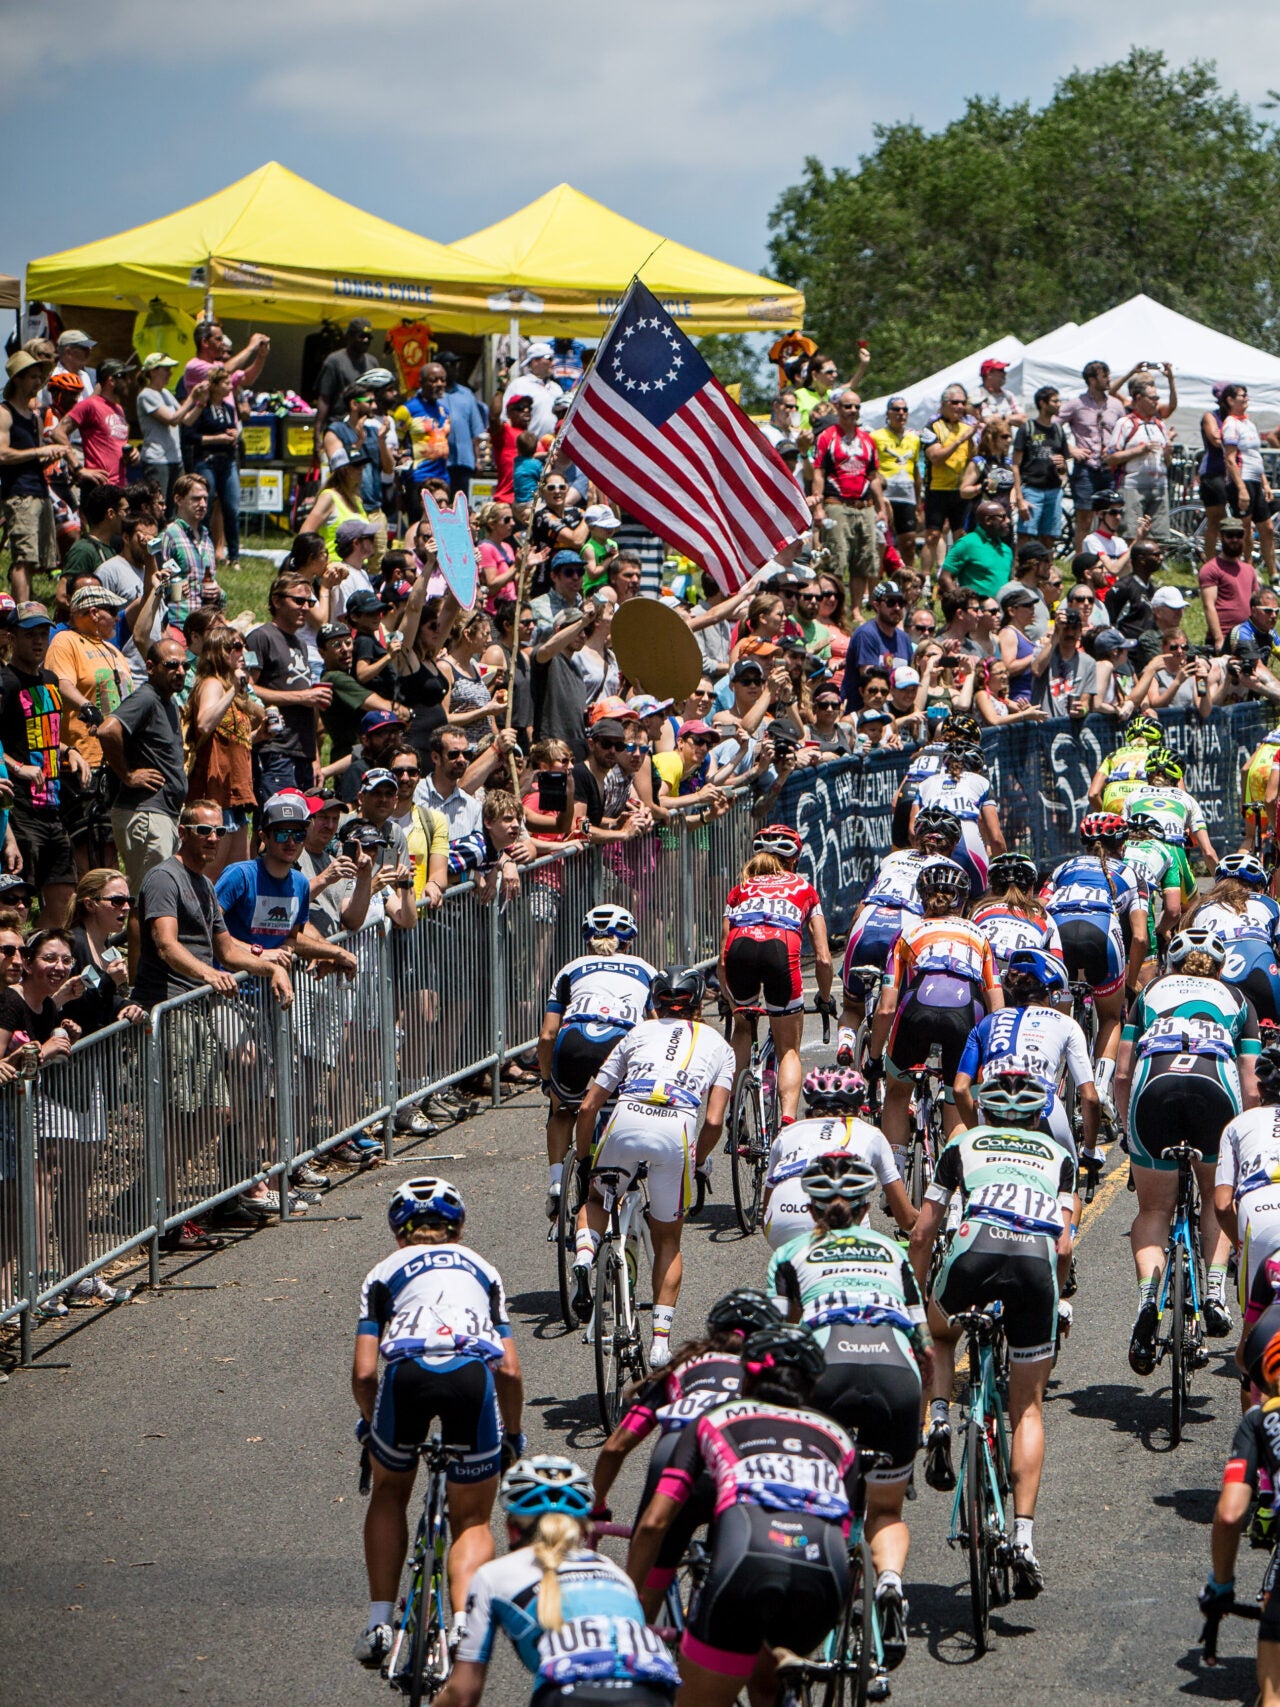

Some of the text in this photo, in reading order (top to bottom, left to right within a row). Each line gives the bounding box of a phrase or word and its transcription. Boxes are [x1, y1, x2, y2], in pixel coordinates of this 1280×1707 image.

[333, 276, 434, 304] LONGS CYCLE
[1084, 886, 1101, 901] 71
[768, 899, 799, 919] 134
[580, 961, 640, 977] bigla
[1035, 1009, 1063, 1021] UHC
[991, 1012, 1018, 1053] UHC
[1198, 1020, 1225, 1041] 55
[665, 1025, 685, 1062] COLOMBIA
[626, 1101, 679, 1120] COLOMBIA
[974, 1135, 1055, 1161] COLAVITA
[985, 1155, 1046, 1172] Bianchi
[779, 1202, 809, 1216] COLO
[980, 1183, 1060, 1223] 172 172
[988, 1226, 1037, 1244] COLAVITA
[808, 1244, 891, 1263] COLAVITA
[402, 1250, 478, 1279] bigla
[821, 1264, 889, 1279] Bianchi
[465, 1307, 496, 1342] 34
[837, 1339, 891, 1354] COLAVITA
[454, 1461, 494, 1477] bigla
